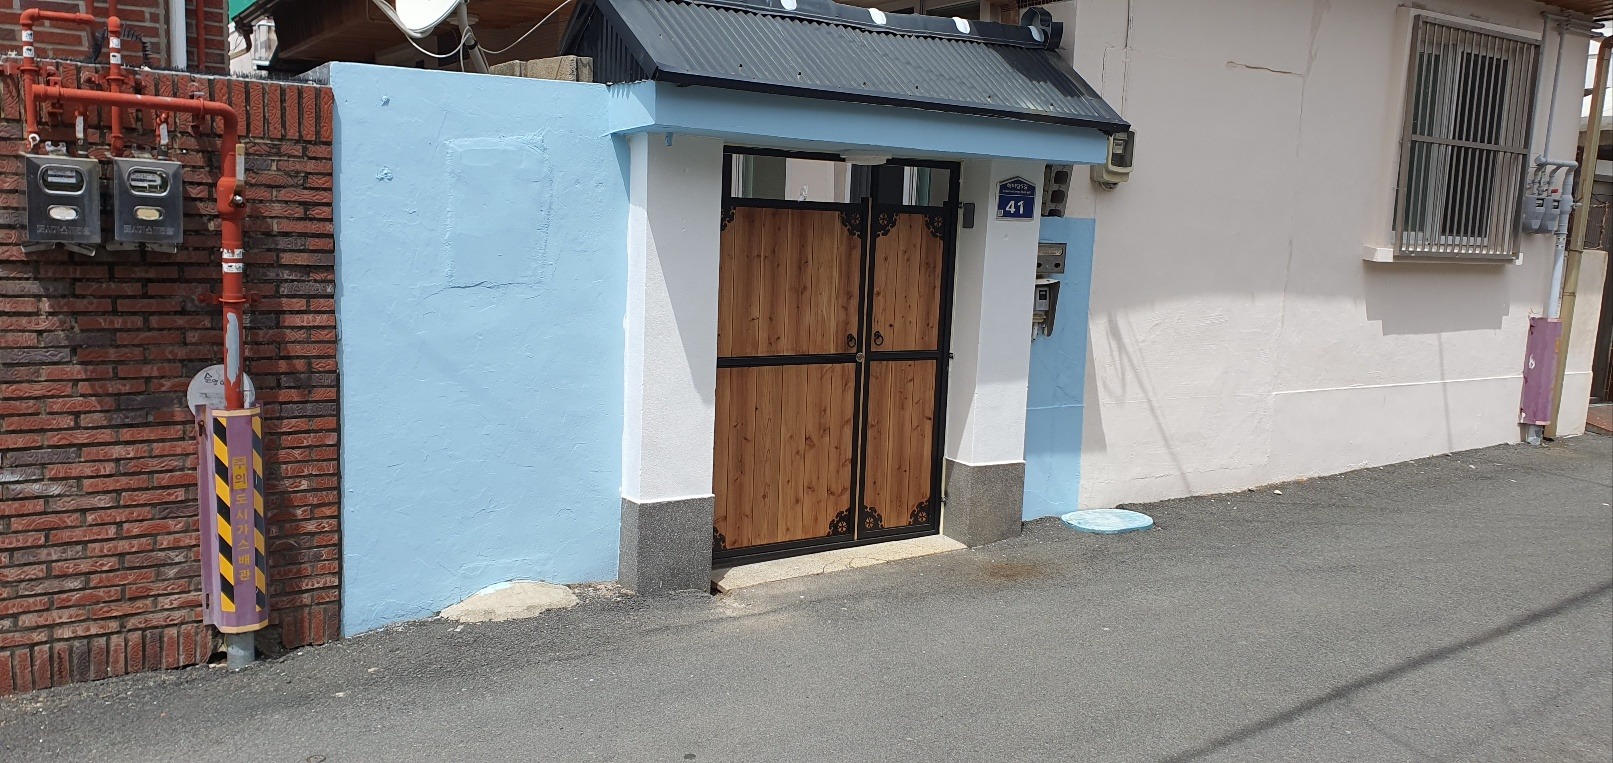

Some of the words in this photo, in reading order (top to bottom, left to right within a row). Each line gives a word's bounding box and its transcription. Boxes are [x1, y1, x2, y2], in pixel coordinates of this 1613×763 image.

[1005, 200, 1025, 215] 41
[233, 457, 247, 486] 주의
[235, 494, 251, 581] 도시가스배관
